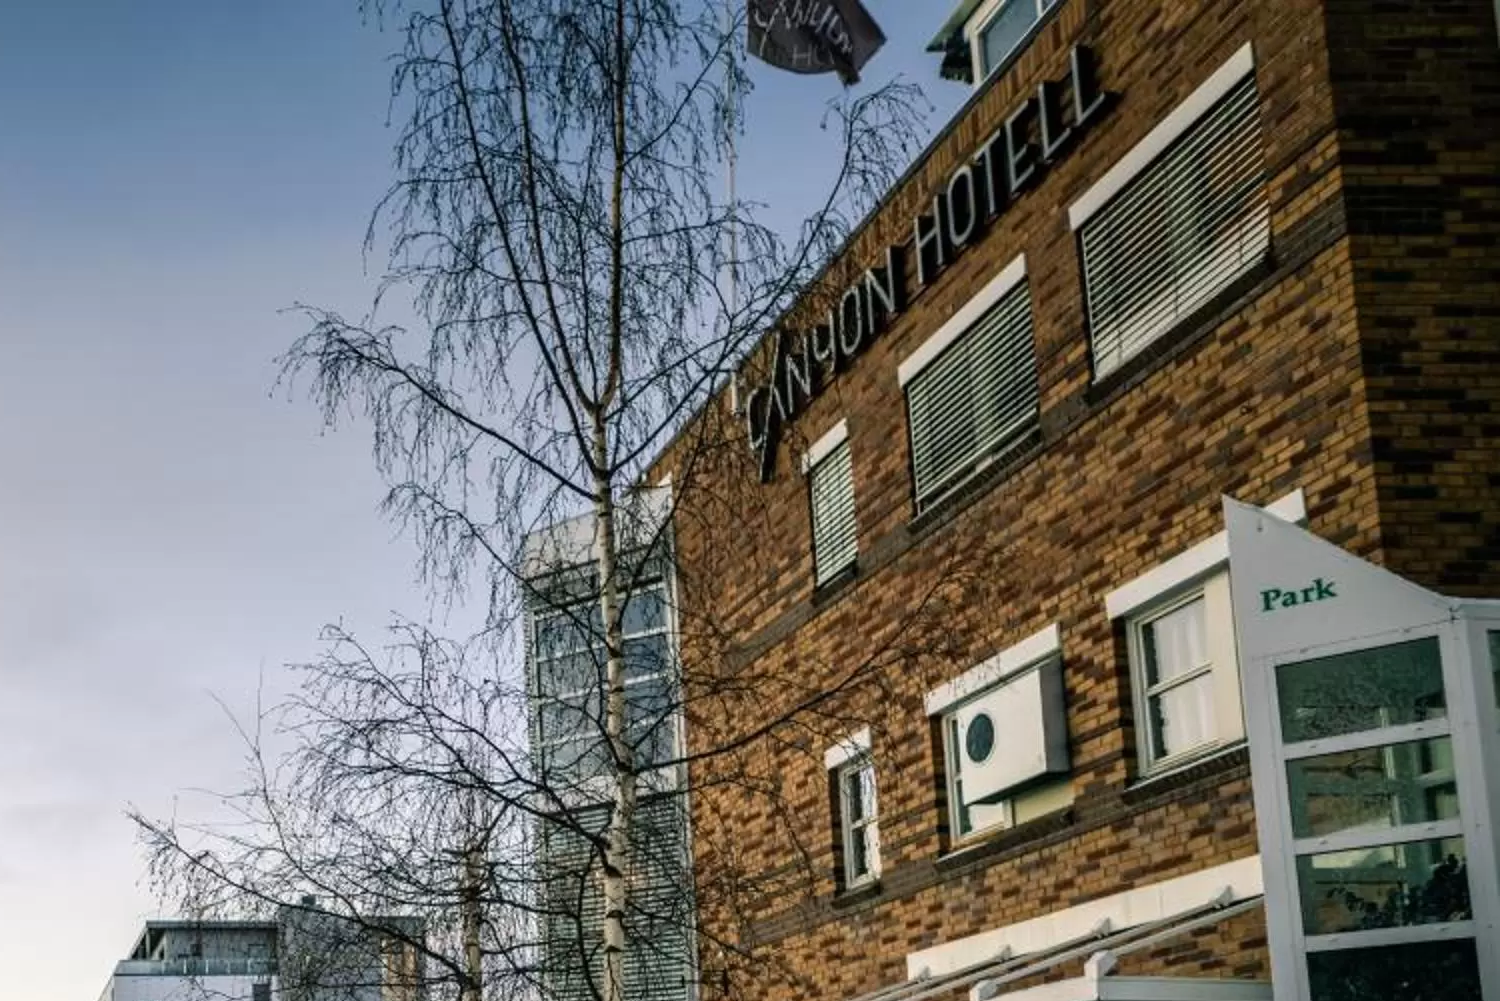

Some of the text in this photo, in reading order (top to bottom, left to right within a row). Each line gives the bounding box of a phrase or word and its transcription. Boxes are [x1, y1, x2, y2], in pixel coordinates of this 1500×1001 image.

[746, 44, 1106, 484] CANYON HOTELL
[1260, 577, 1339, 612] Park
